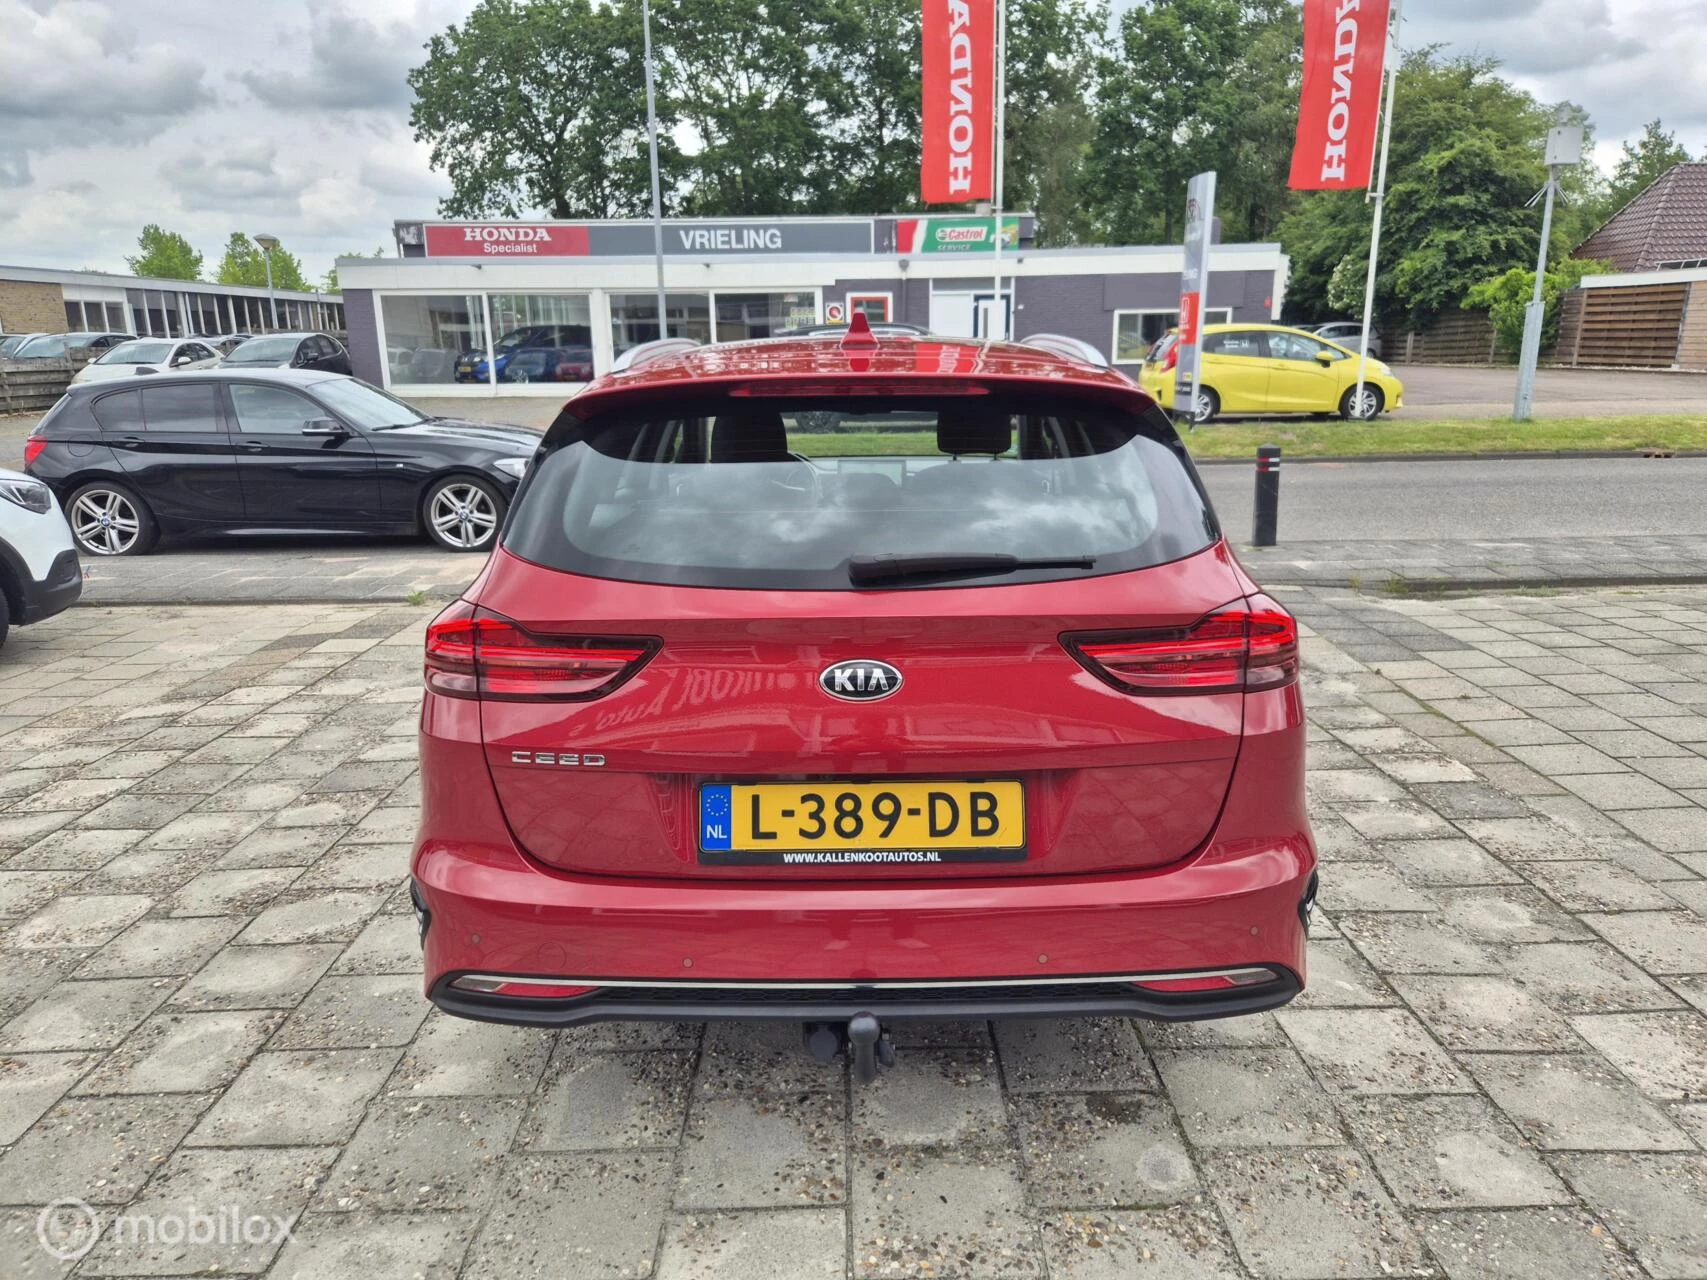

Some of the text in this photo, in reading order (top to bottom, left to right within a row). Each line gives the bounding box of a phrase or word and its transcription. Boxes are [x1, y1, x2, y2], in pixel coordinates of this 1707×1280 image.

[947, 0, 973, 195] HONDA
[463, 227, 552, 241] HONDA
[679, 228, 782, 250] VRIELING
[948, 229, 984, 240] Castrol
[483, 242, 537, 254] Specialist
[834, 668, 889, 691] KIA
[511, 750, 606, 767] CEED
[751, 791, 1000, 840] L-389-DB
[706, 824, 727, 839] NL
[783, 851, 942, 864] WWW.KALLENKOOTAUTOS.NL
